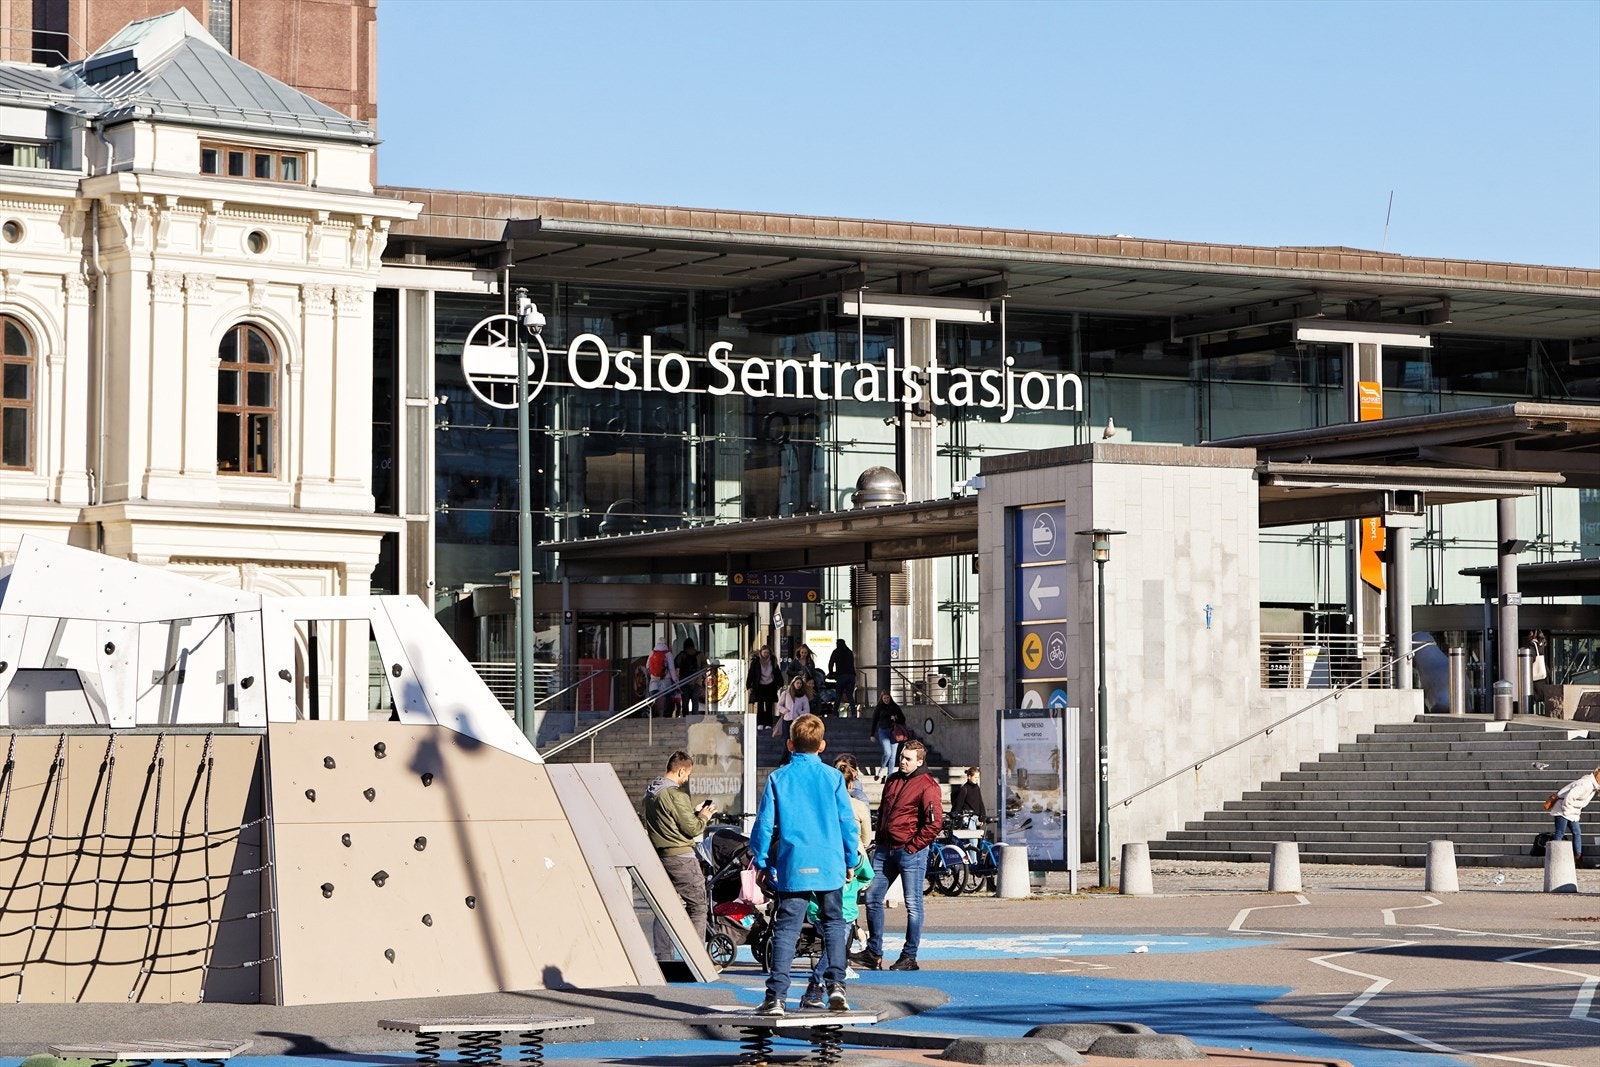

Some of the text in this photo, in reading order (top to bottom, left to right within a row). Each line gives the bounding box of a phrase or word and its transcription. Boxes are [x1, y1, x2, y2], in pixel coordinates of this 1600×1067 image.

[567, 333, 1083, 423] Oslo Sentralstasjon
[763, 574, 785, 585] 1-12
[763, 590, 791, 600] 13-19
